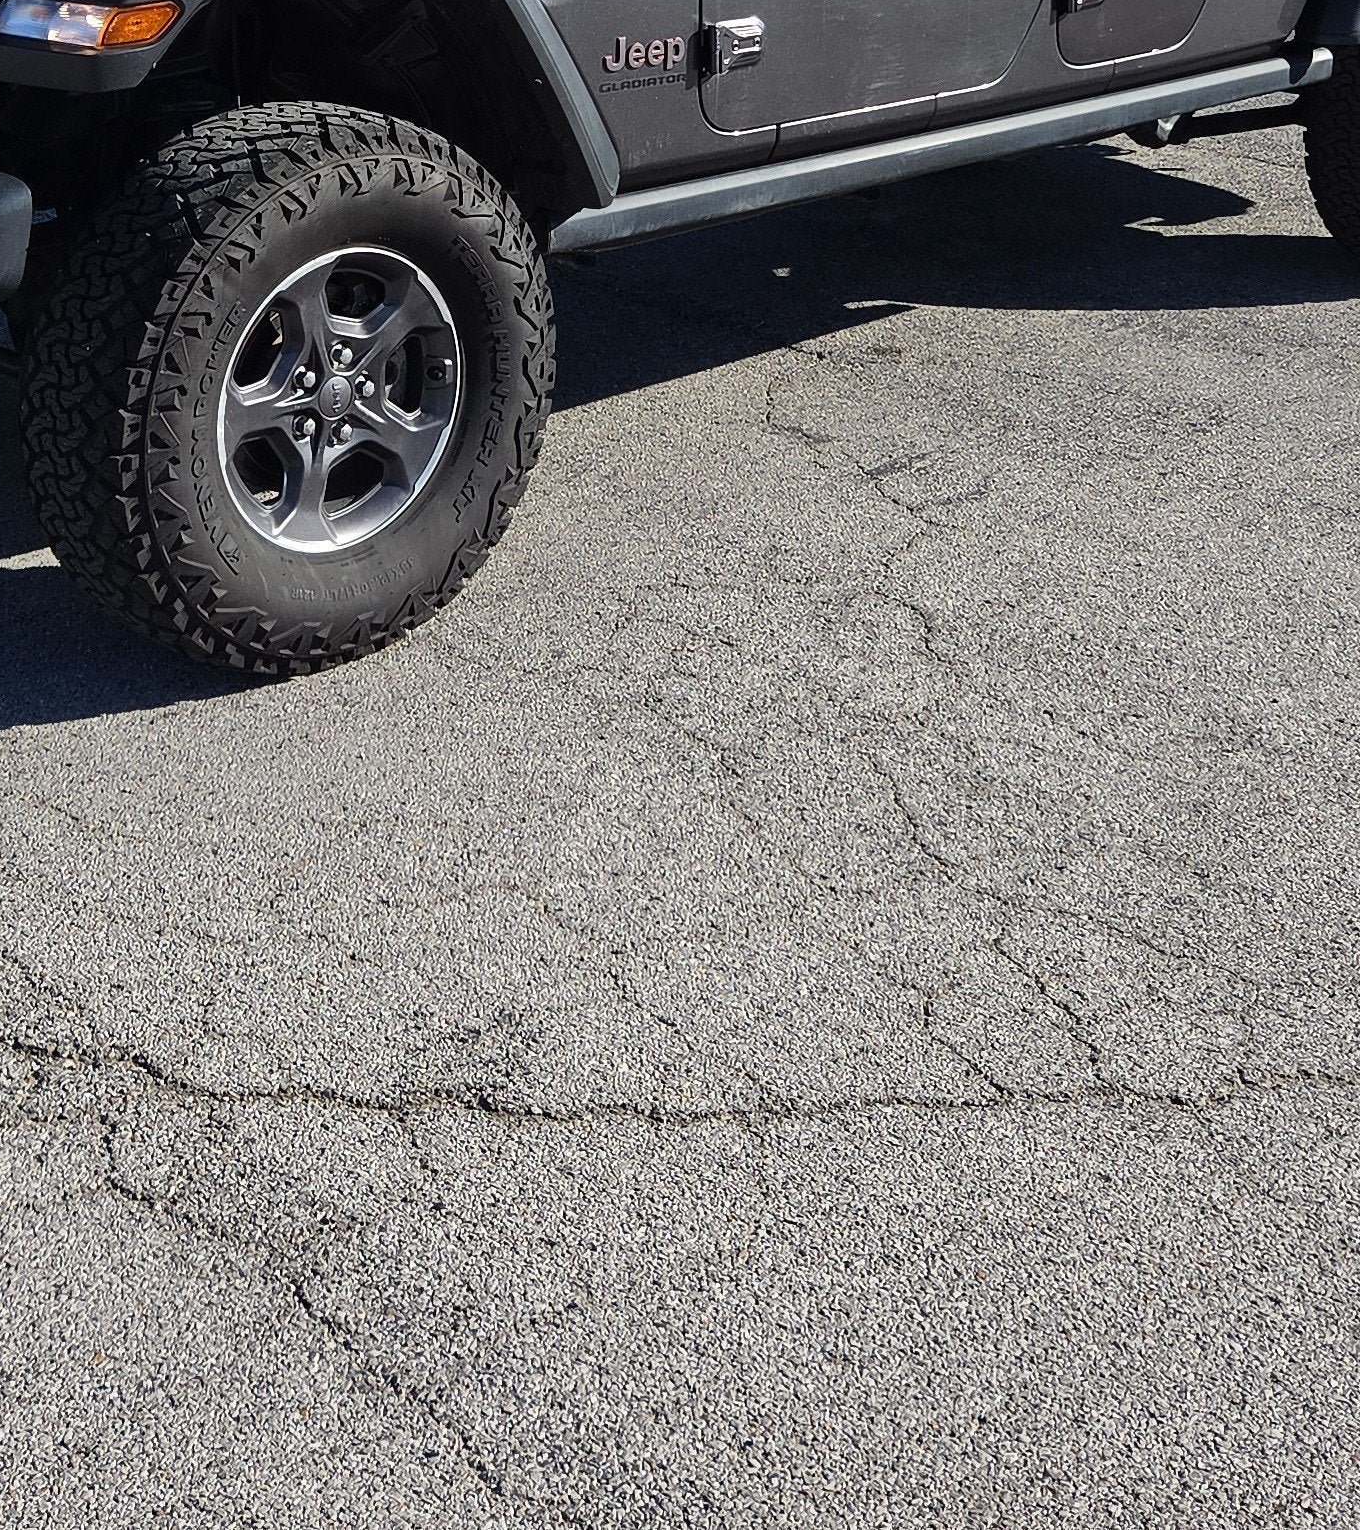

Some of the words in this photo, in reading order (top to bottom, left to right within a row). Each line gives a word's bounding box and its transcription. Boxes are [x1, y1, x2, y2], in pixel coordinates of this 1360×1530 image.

[601, 35, 686, 73] Jeep
[598, 73, 687, 94] GLADIATOR
[476, 329, 512, 468] HUNTER
